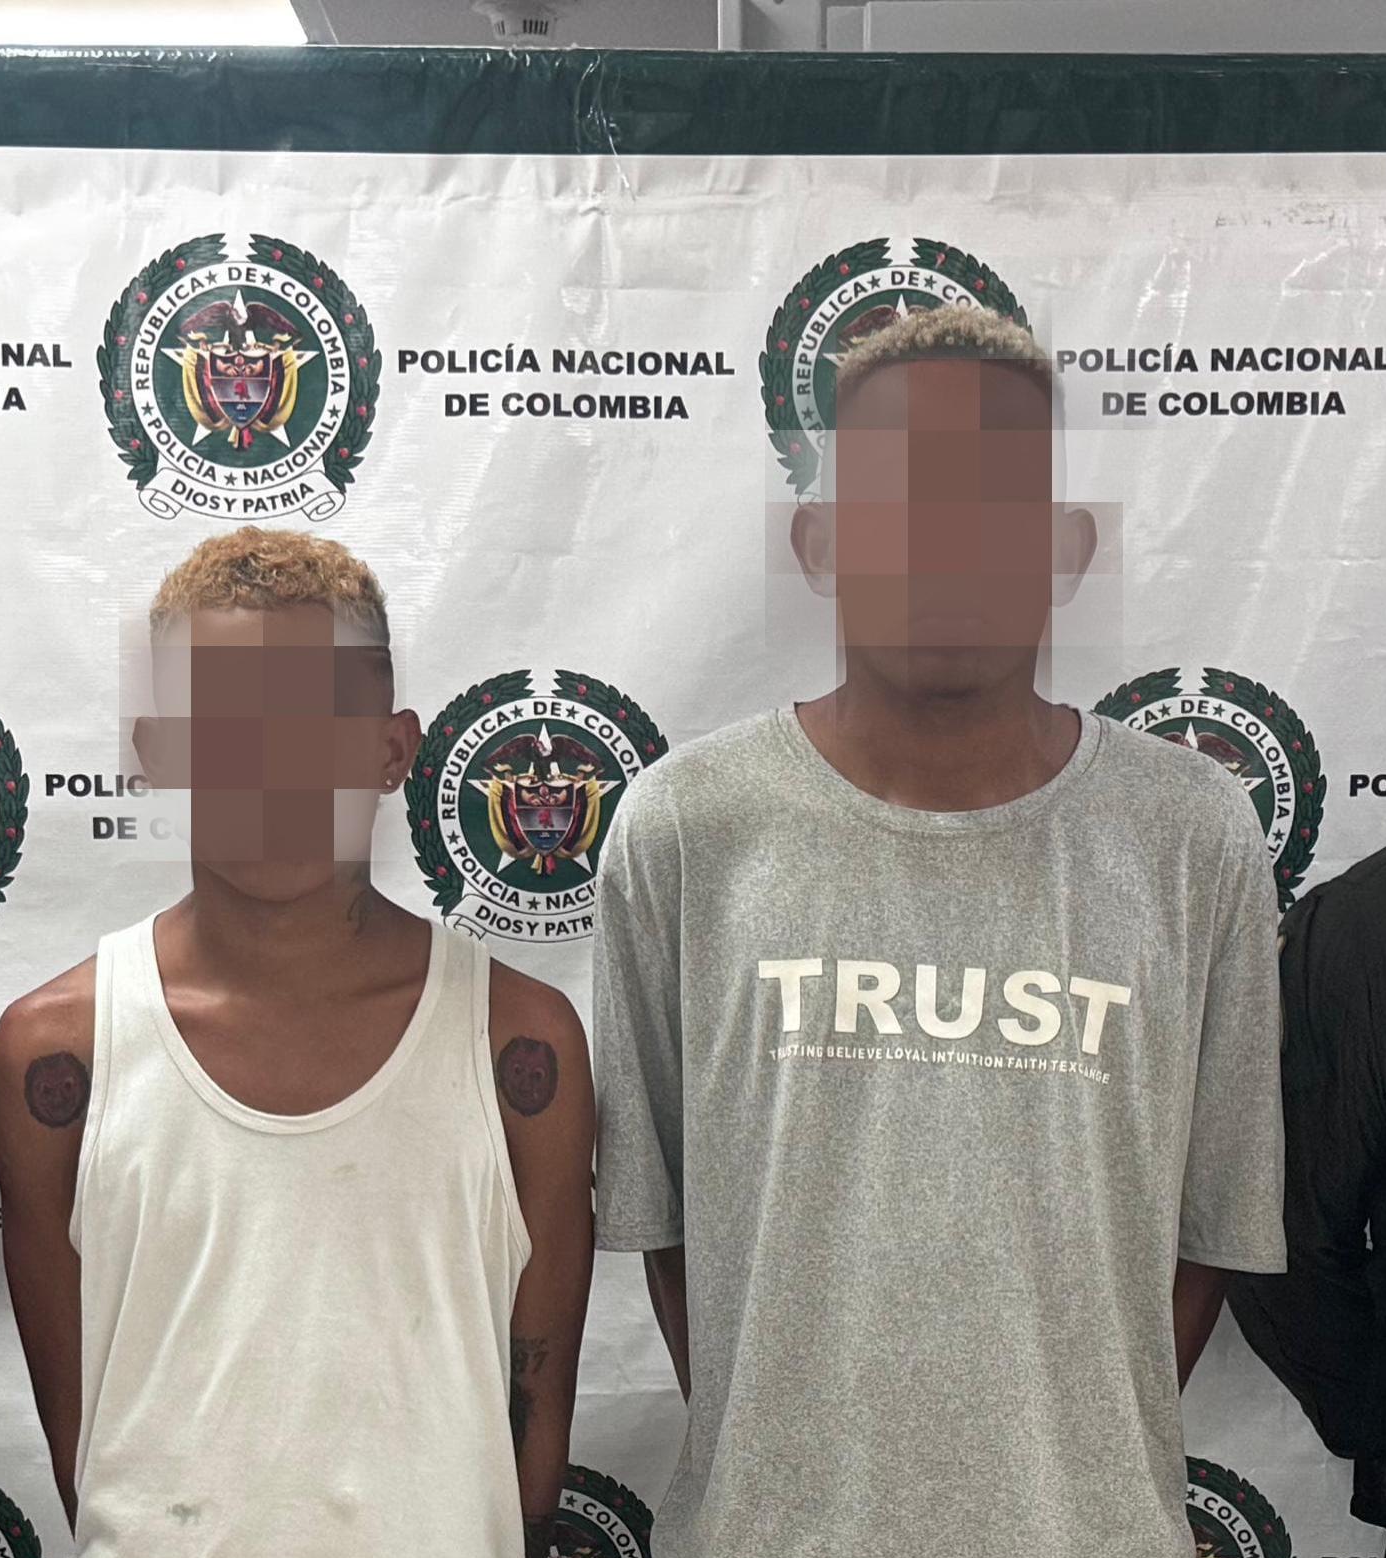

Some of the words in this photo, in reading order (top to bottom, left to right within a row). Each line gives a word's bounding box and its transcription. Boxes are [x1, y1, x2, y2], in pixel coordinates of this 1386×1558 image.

[892, 272, 919, 286] DE
[229, 268, 256, 282] DE
[281, 283, 344, 394] COLOMBIA
[398, 343, 540, 373] POLICÍA
[553, 350, 734, 375] NACIONAL
[1057, 343, 1198, 372] POLICÍA
[445, 393, 489, 416] DE
[502, 393, 689, 419] COLOMBIA
[1103, 392, 1146, 416] DE
[1159, 392, 1345, 416] COLOMBIA
[244, 422, 335, 484] NACIONAL
[244, 483, 313, 512] PATRIA
[534, 702, 561, 716] DE
[1182, 700, 1208, 714] DE
[1232, 713, 1290, 819] COLOMBIA
[758, 957, 1131, 1055] TRUST
[827, 1046, 883, 1059] BELIEVE
[886, 1047, 928, 1062] LOYAL
[933, 1050, 1003, 1068] INTUITION
[1007, 1056, 1047, 1071] FAITH
